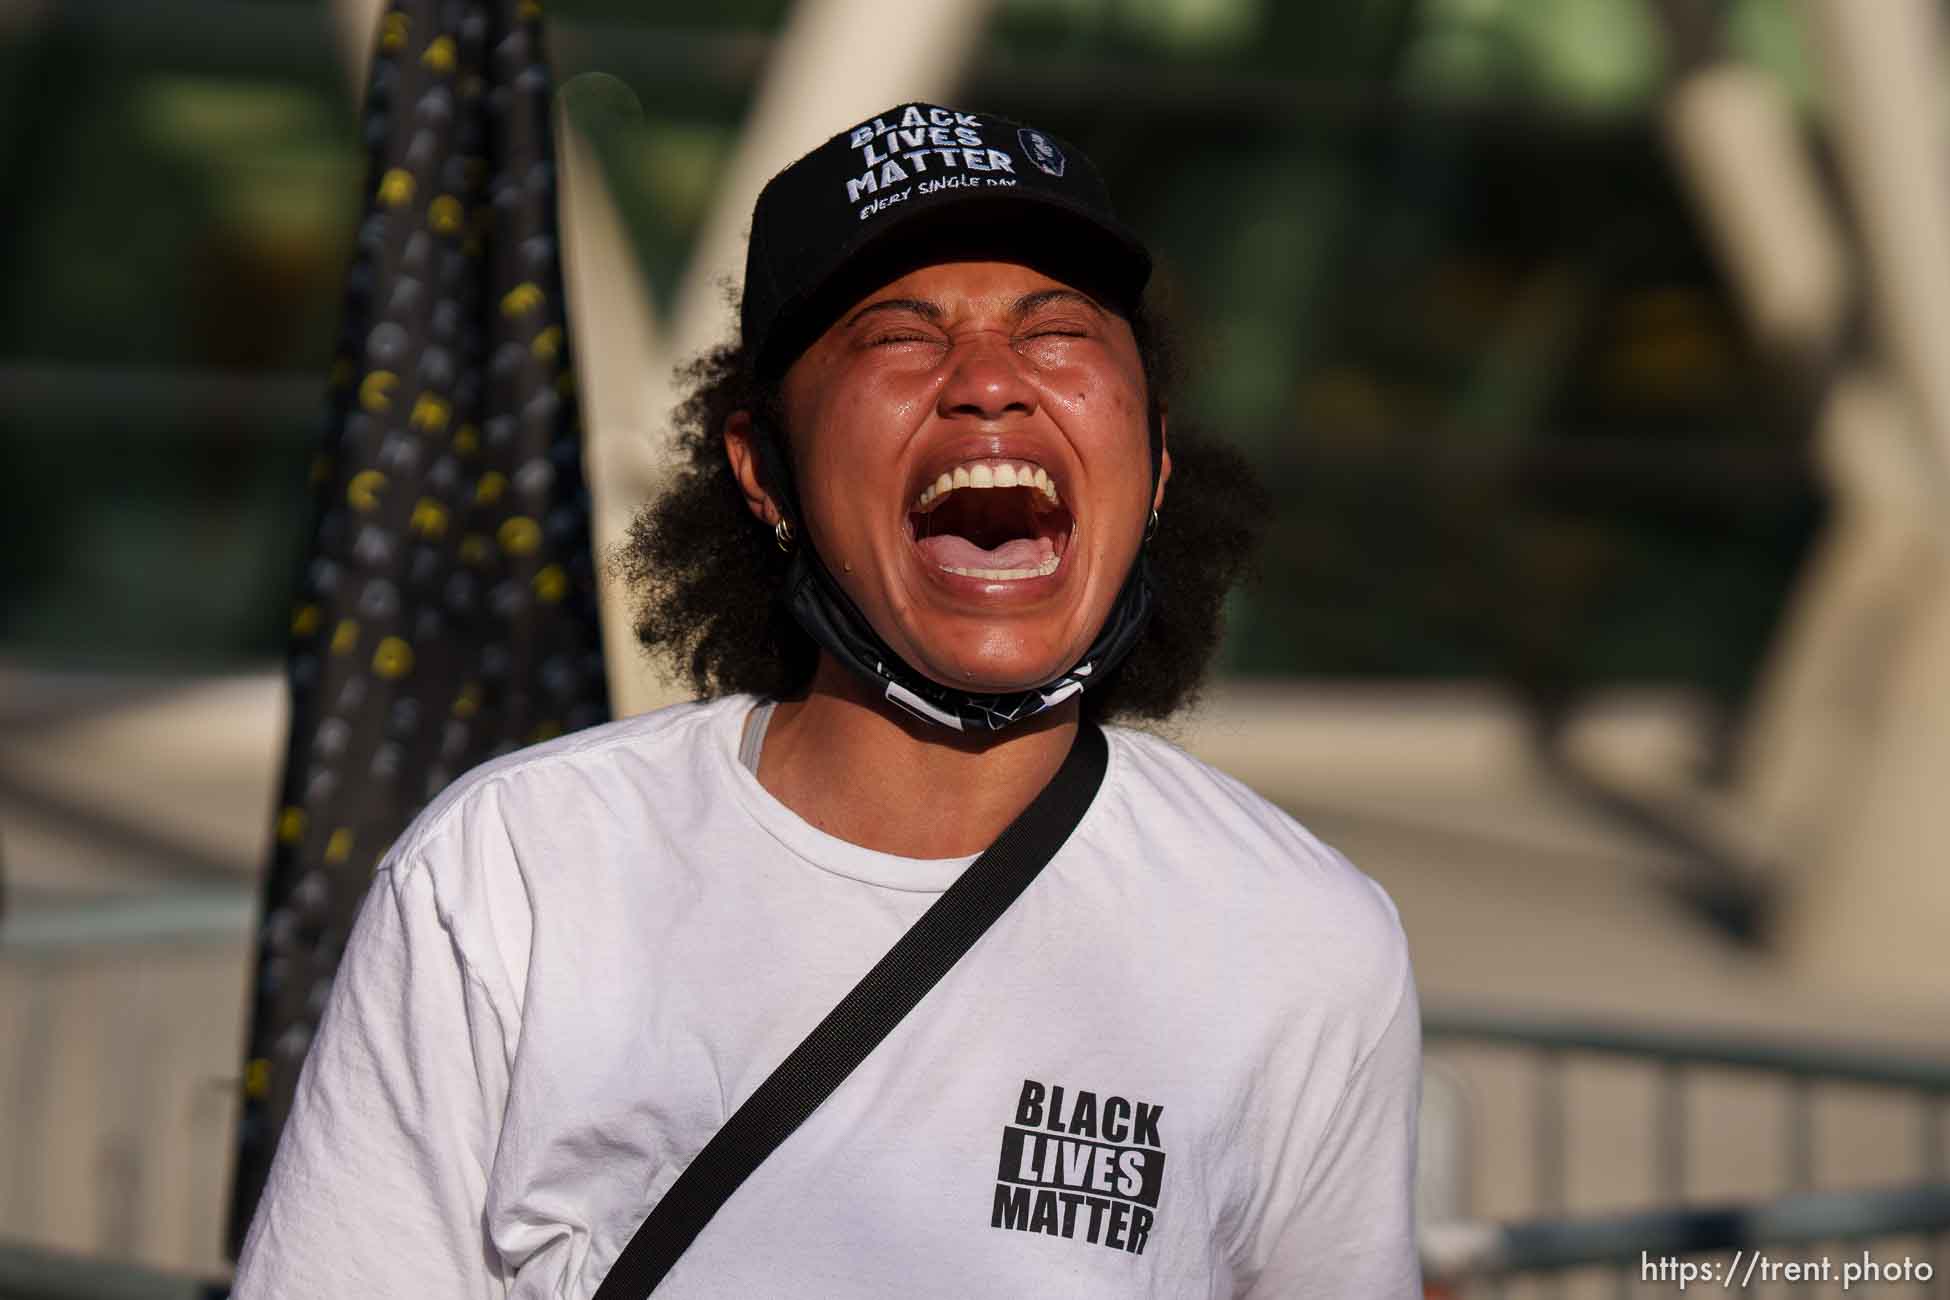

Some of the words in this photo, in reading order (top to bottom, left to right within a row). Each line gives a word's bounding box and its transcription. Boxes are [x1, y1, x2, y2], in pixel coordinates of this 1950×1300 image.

[851, 105, 983, 149] BLACK
[863, 126, 983, 168] LIVES
[846, 147, 1016, 203] MATTER
[860, 186, 912, 221] EVERY
[918, 174, 981, 195] SINGLE
[1015, 1079, 1164, 1148] BLACK
[1018, 1134, 1145, 1197] LIVES
[991, 1183, 1154, 1255] MATTER
